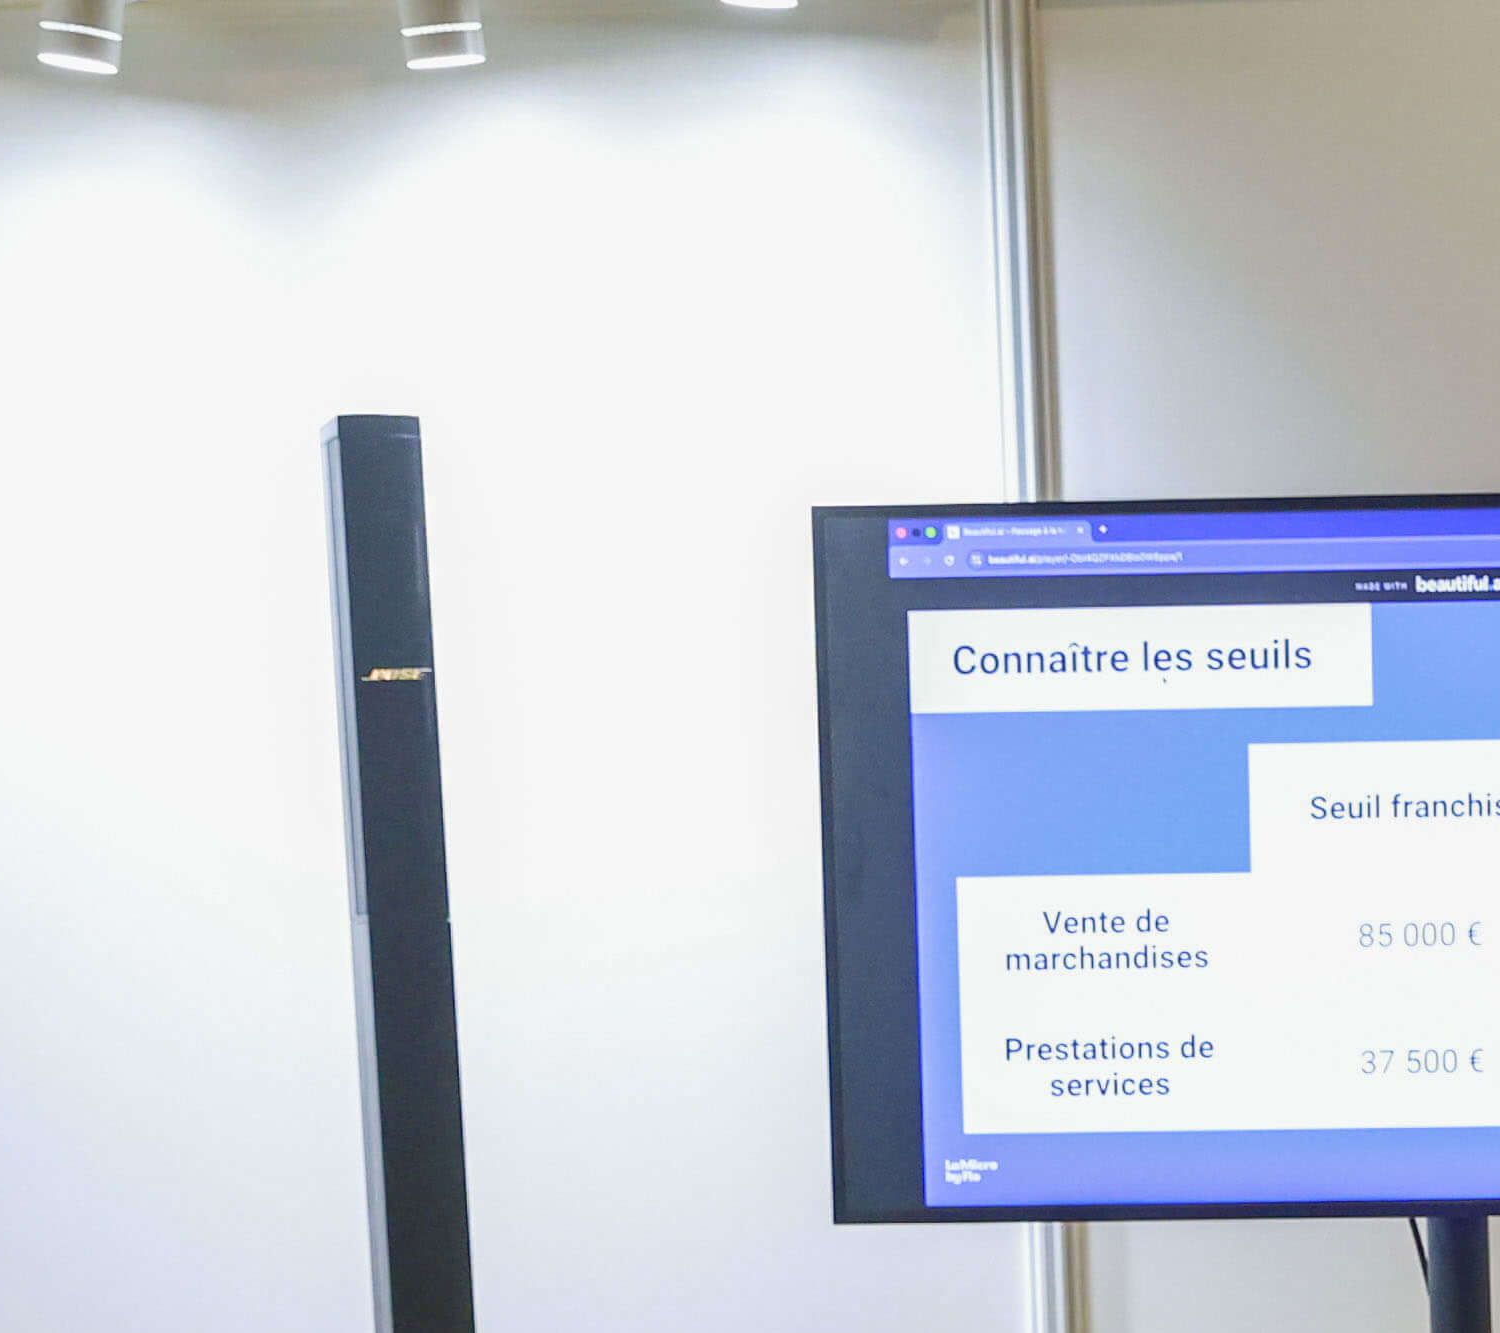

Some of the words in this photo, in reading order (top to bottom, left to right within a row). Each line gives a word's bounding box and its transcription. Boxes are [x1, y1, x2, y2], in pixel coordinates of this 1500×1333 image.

[953, 642, 1129, 675] Connaître
[1143, 641, 1193, 672] les
[1206, 638, 1313, 671] seuils
[1309, 794, 1381, 820] Seuil
[1043, 910, 1126, 934] Vente
[1136, 907, 1170, 933] de
[1357, 922, 1394, 949] 85
[1402, 921, 1457, 948] 000
[1466, 921, 1483, 947] €
[1005, 944, 1210, 971] marchandises
[1005, 1035, 1171, 1061] Prestations
[1180, 1033, 1215, 1059] de
[1360, 1050, 1395, 1075] 37
[1405, 1049, 1459, 1074] 500
[1468, 1048, 1485, 1073] €
[1050, 1072, 1171, 1097] services
